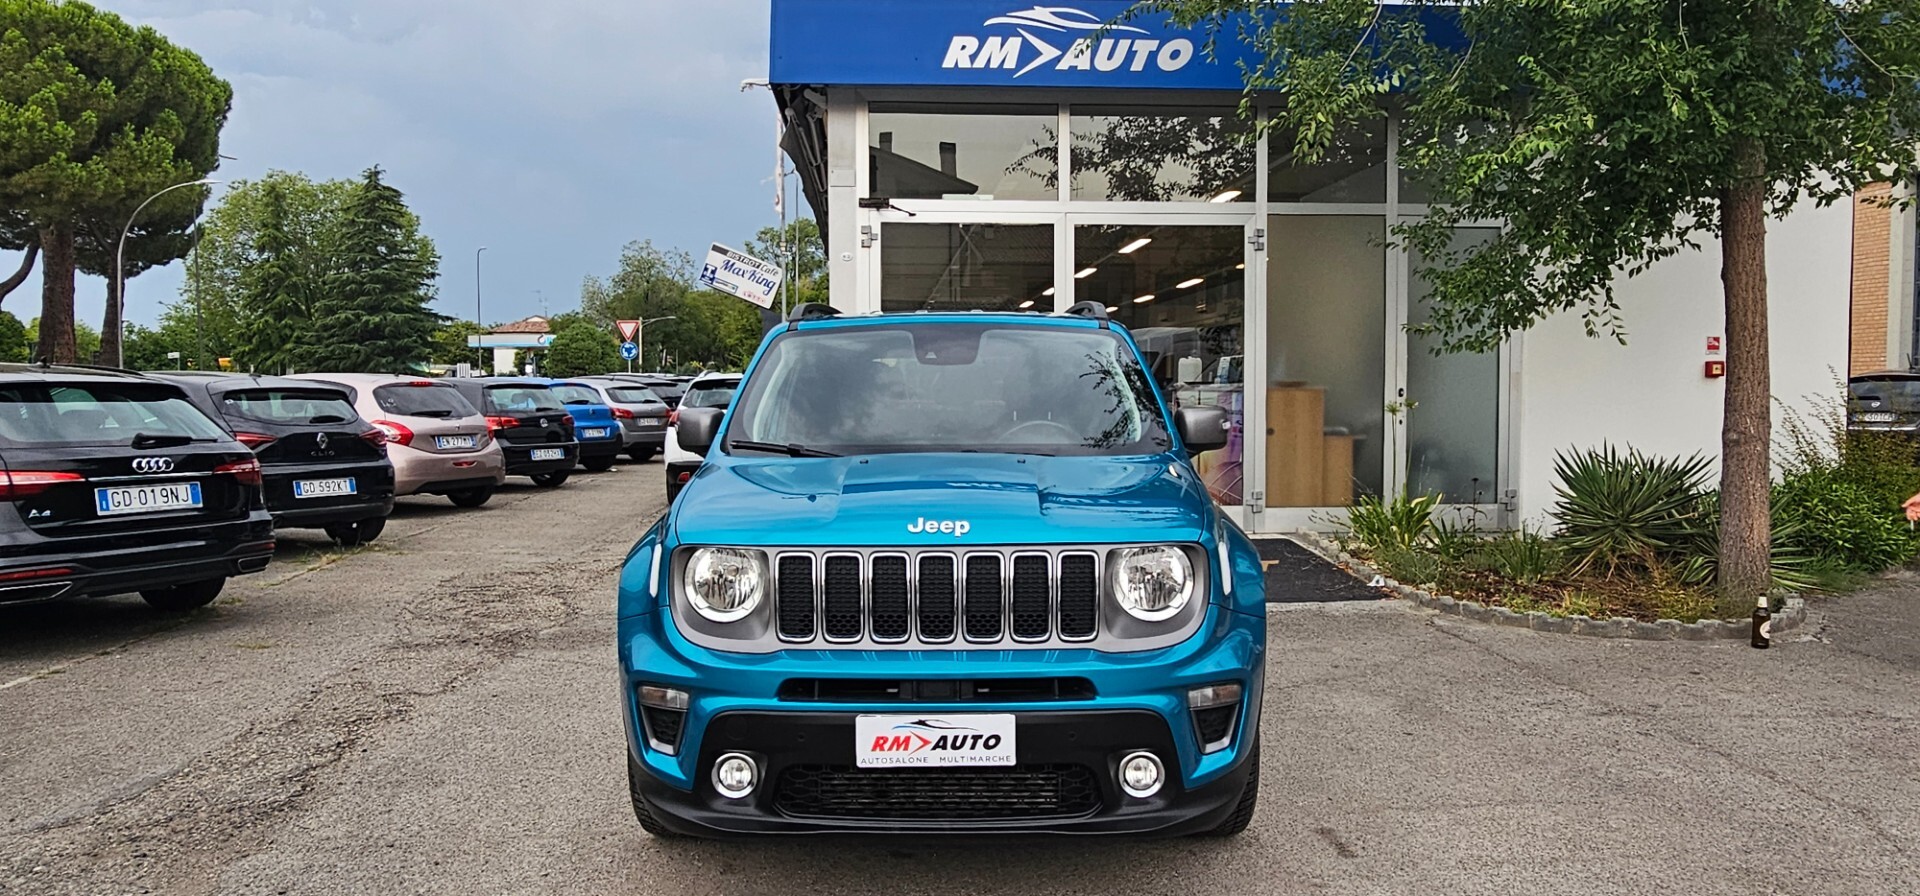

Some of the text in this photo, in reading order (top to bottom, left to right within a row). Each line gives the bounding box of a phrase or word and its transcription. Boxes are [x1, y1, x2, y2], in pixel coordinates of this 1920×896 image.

[726, 250, 762, 269] BISTROT
[302, 481, 316, 494] GD
[318, 480, 348, 493] 592KT
[110, 490, 132, 508] GD
[138, 486, 190, 506] 019NJ
[28, 509, 51, 518] A4
[907, 517, 971, 537] Jeep
[861, 755, 1012, 765] AUTOSALONE MULTIMARCHE
